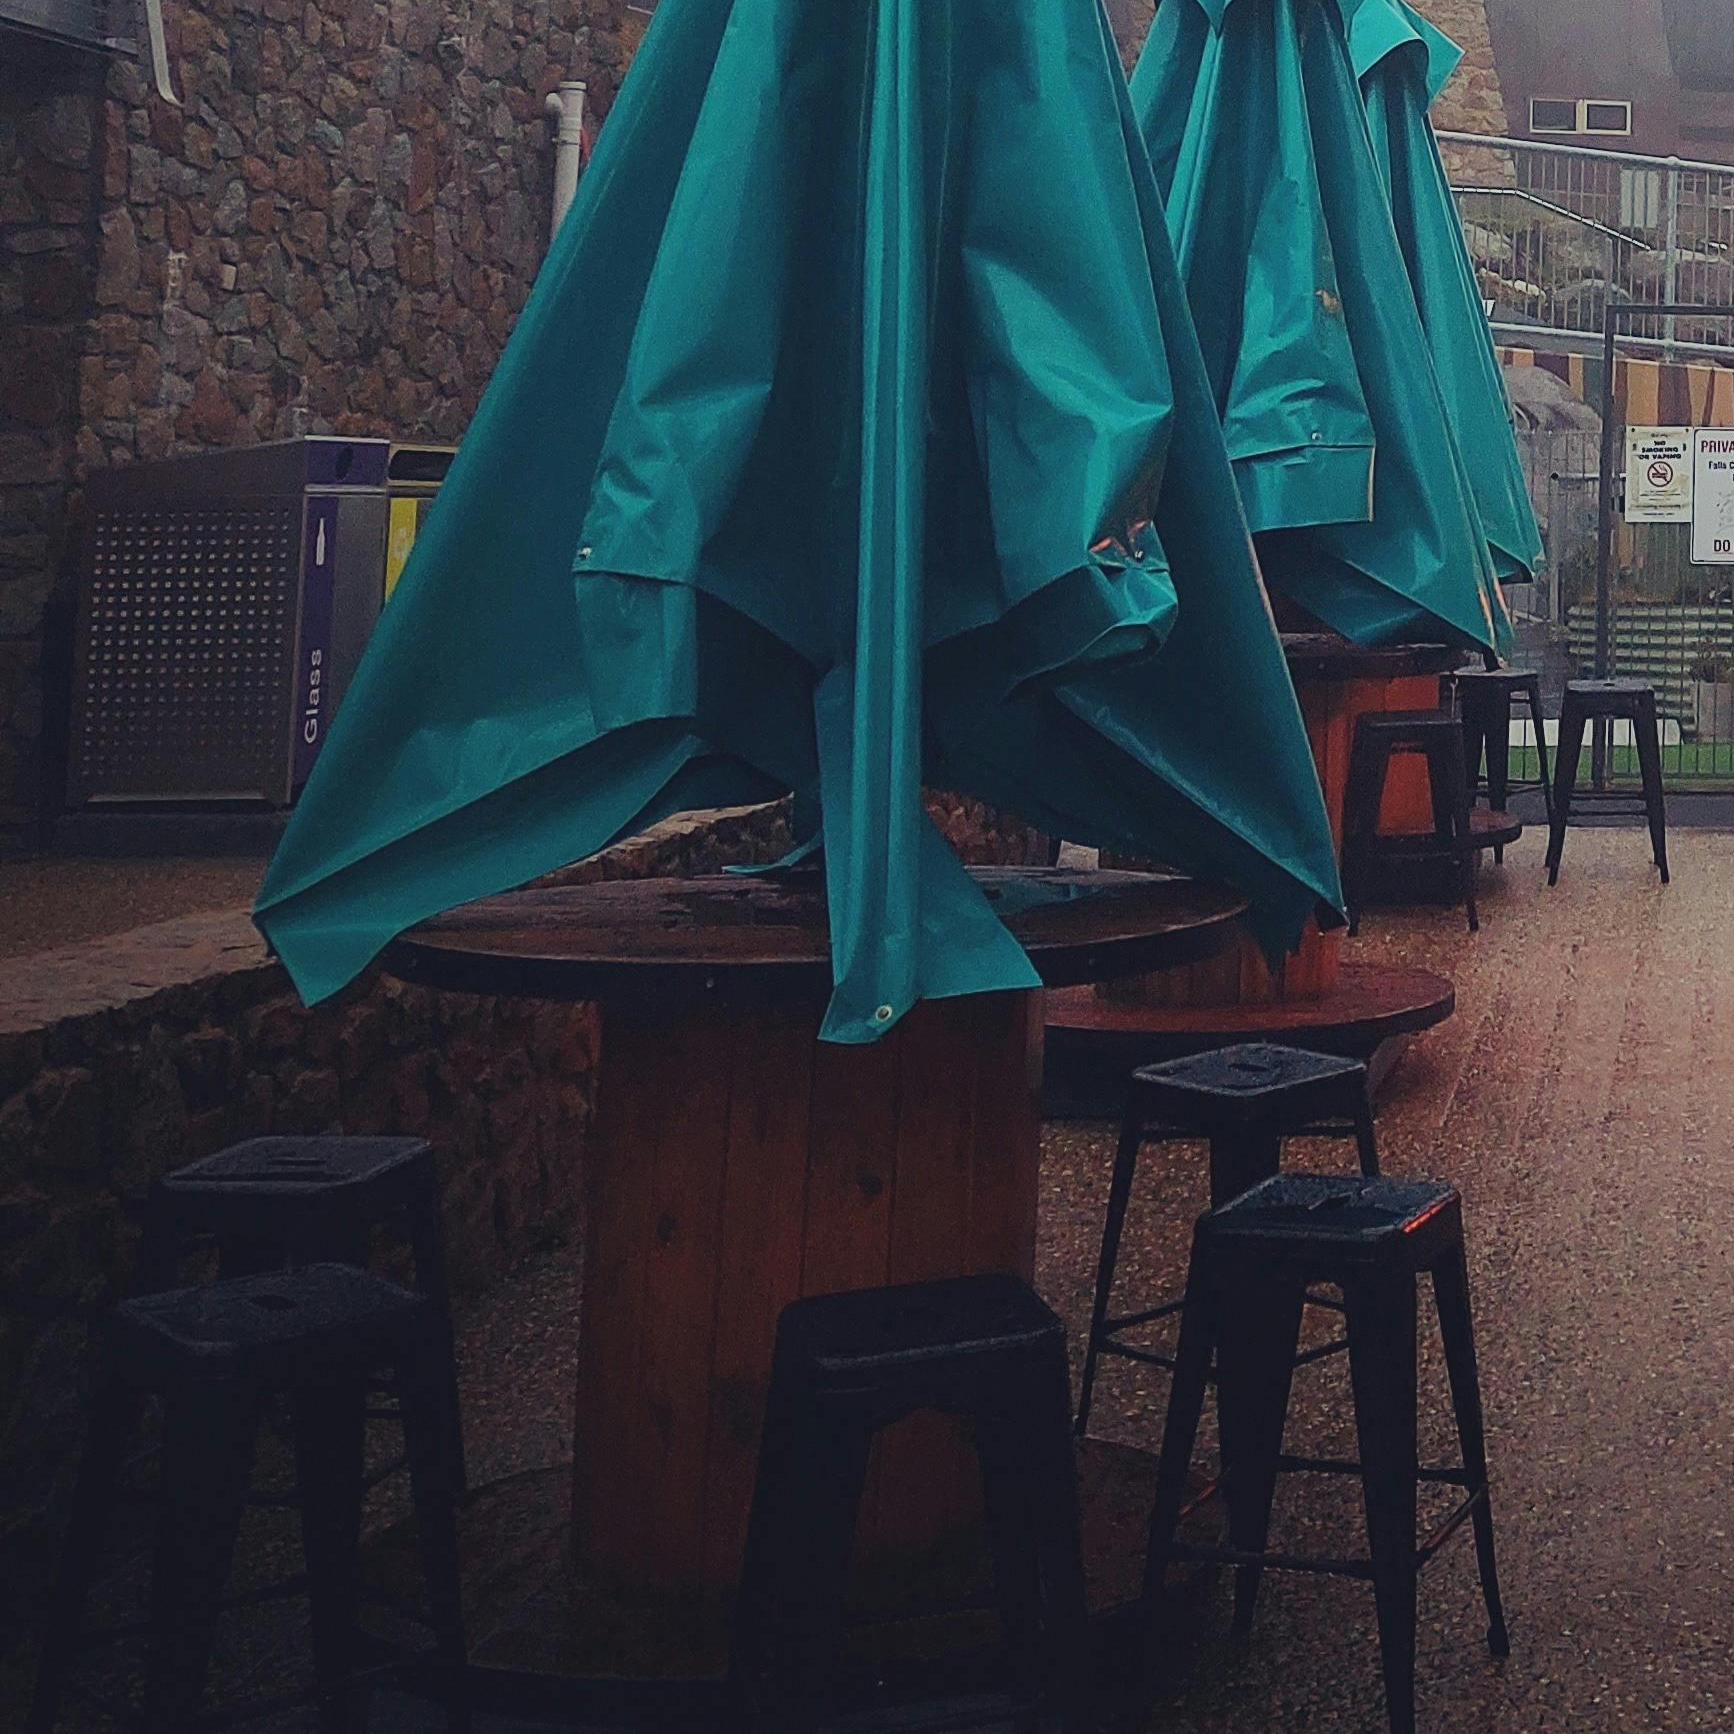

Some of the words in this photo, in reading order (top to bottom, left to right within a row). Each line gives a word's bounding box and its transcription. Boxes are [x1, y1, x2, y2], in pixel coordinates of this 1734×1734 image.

[1708, 460, 1727, 471] Falls
[1713, 539, 1732, 553] DO
[304, 649, 322, 743] Glass
